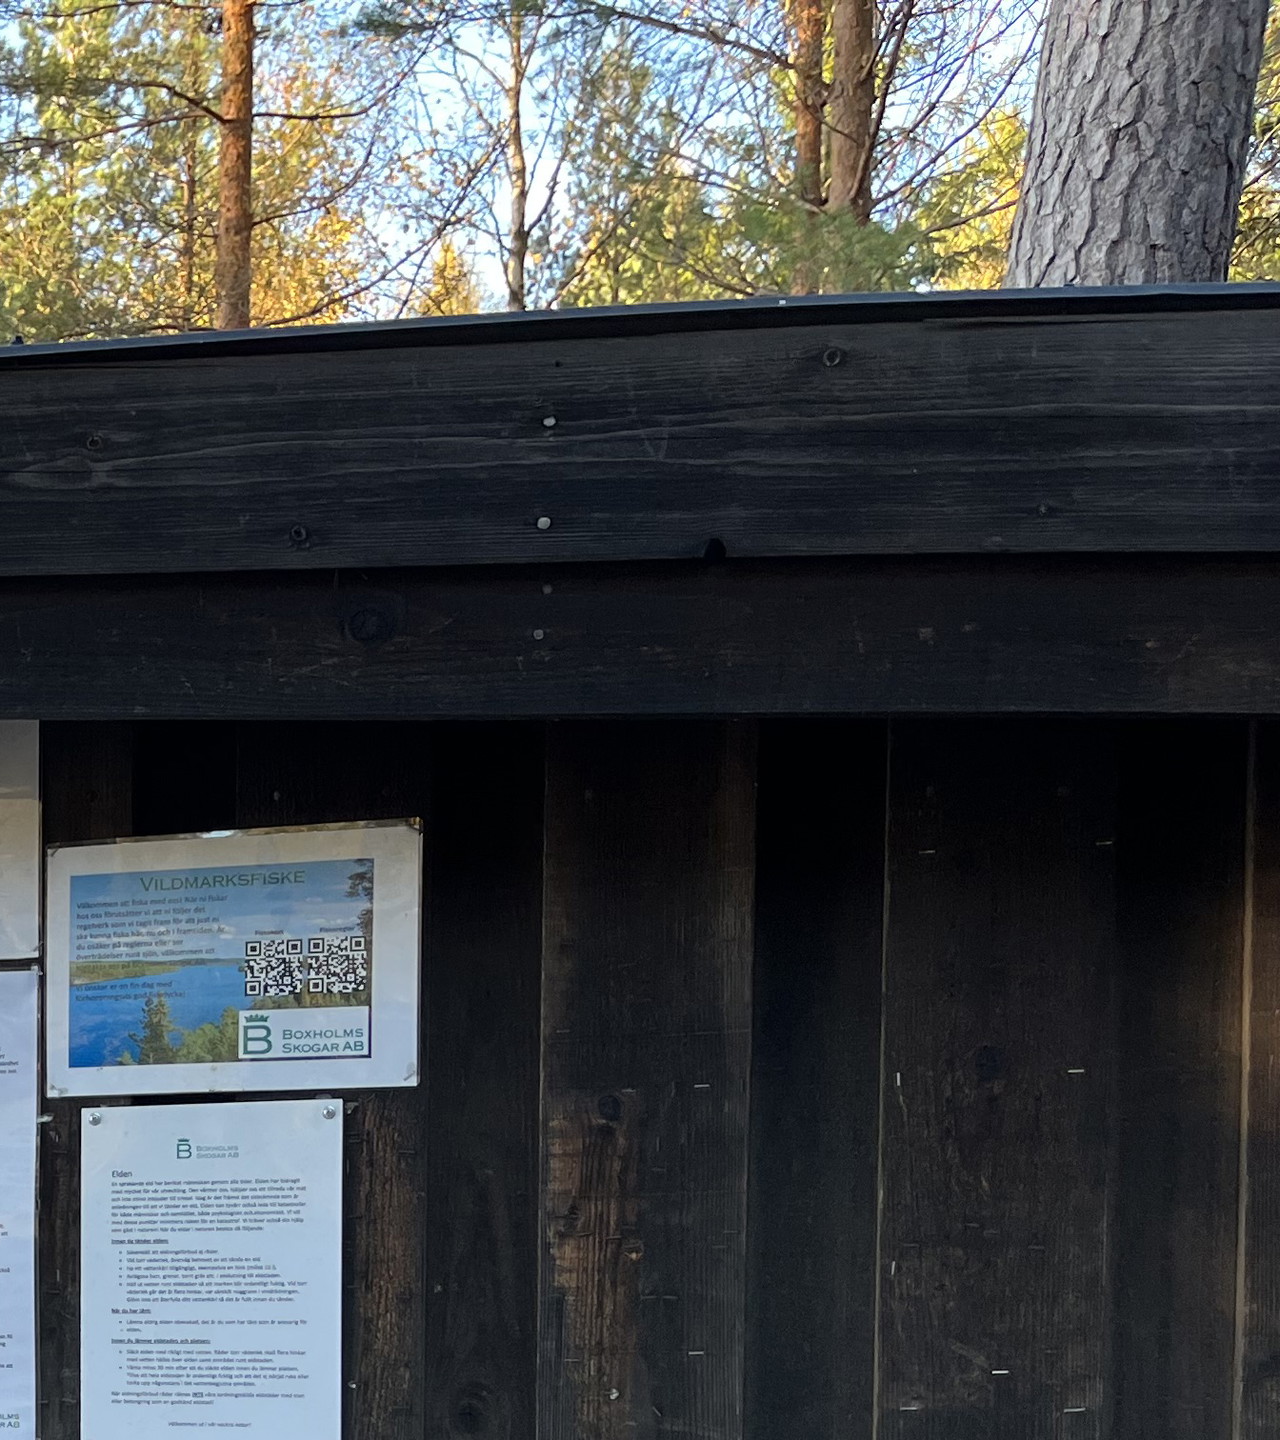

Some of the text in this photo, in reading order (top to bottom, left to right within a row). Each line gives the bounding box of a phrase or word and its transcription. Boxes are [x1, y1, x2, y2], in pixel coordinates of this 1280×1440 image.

[139, 870, 305, 890] VILDMARKSFISKE
[243, 1025, 272, 1055] B
[282, 1028, 363, 1039] BOXHOLMS
[282, 1040, 364, 1053] SKOGAR AB
